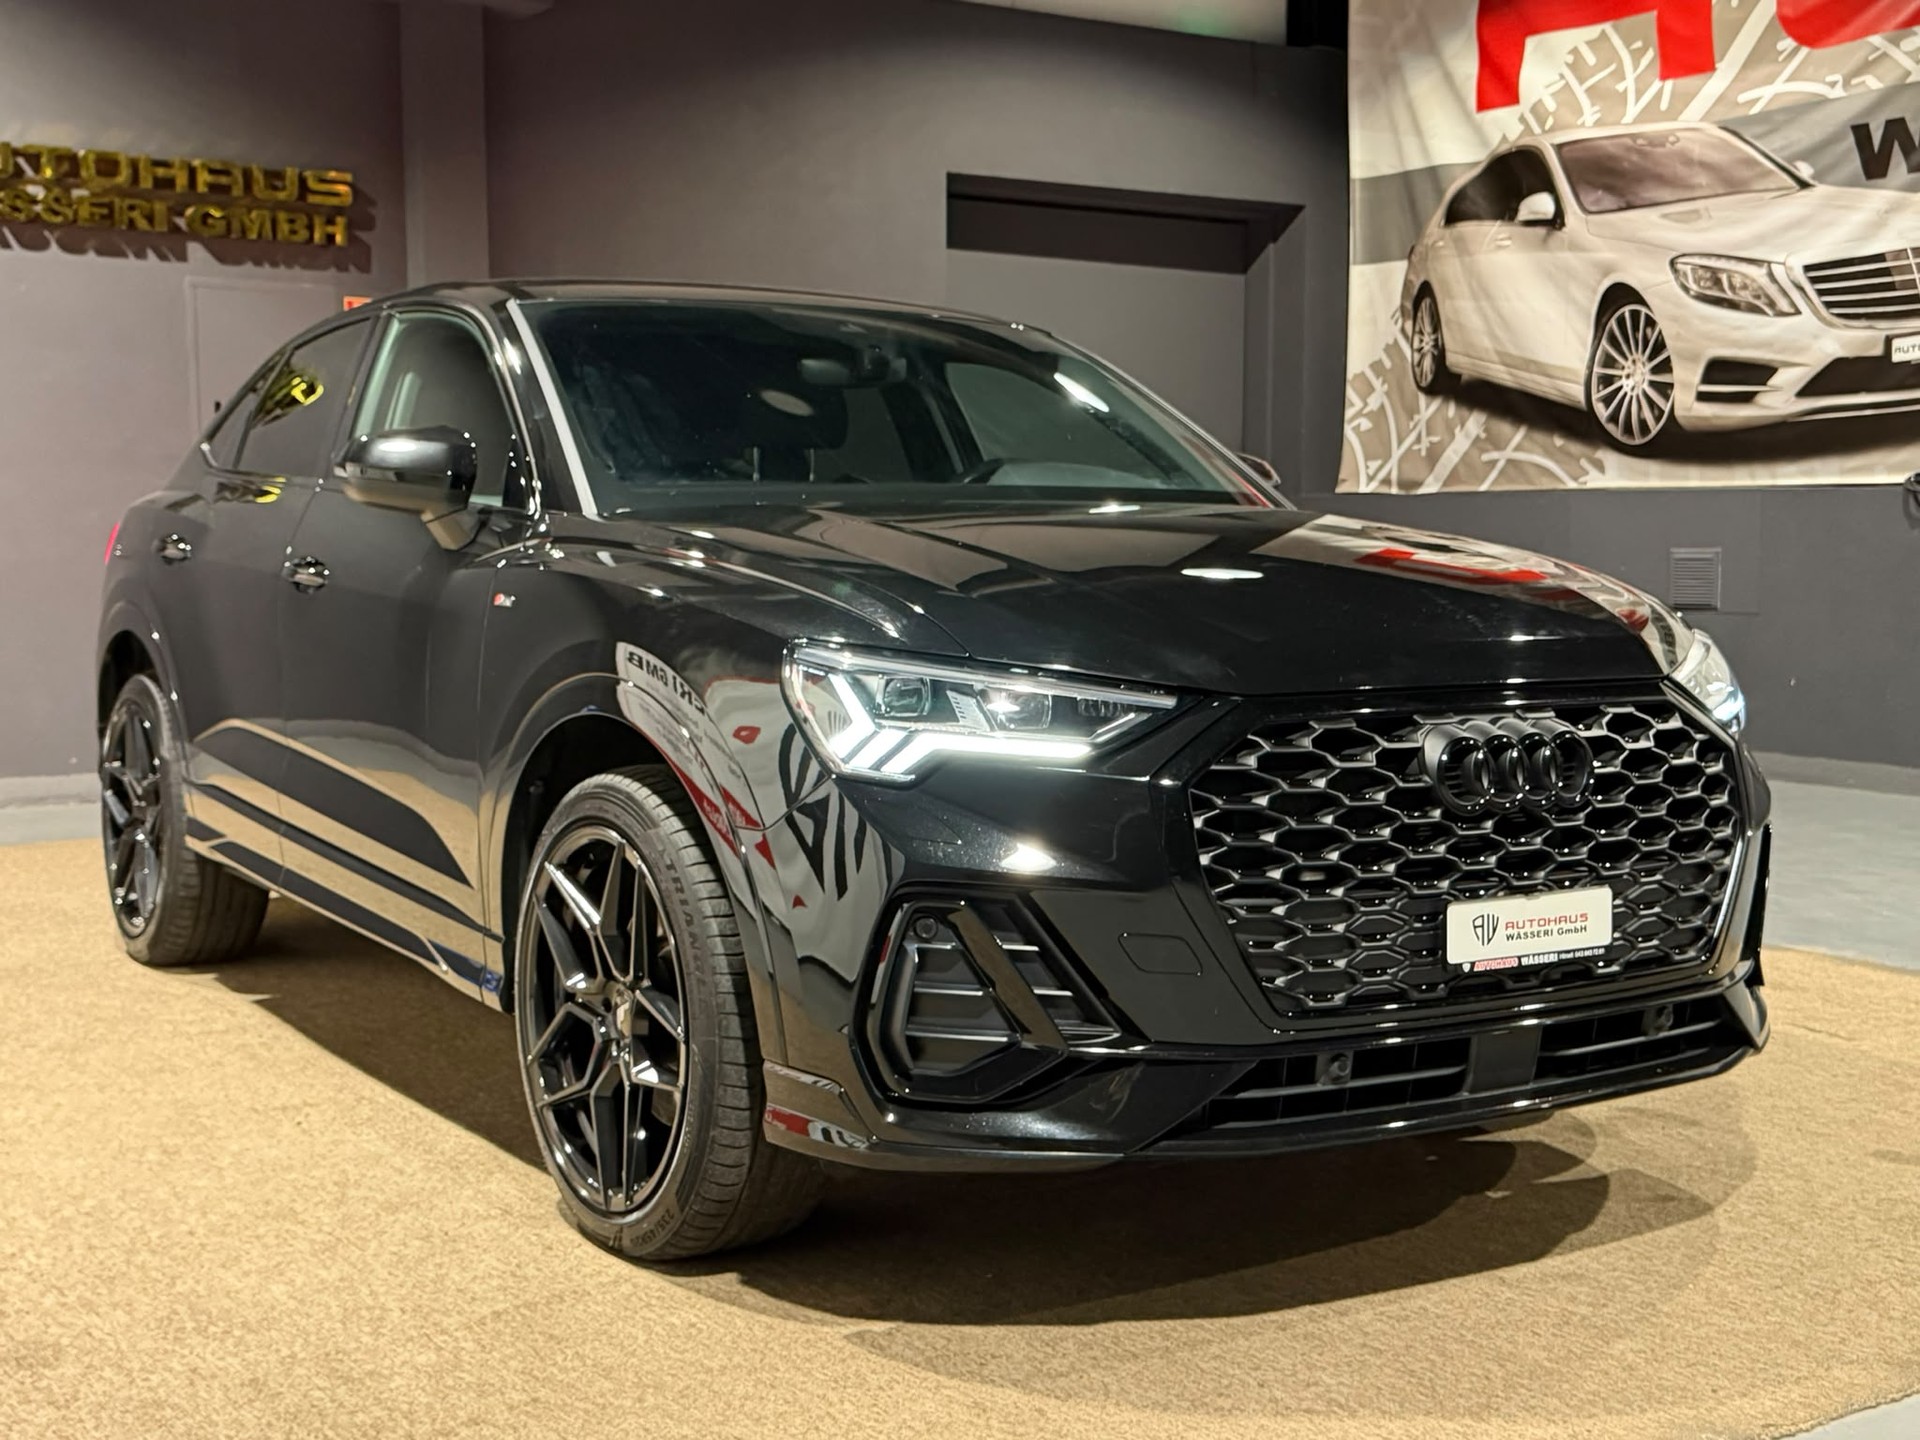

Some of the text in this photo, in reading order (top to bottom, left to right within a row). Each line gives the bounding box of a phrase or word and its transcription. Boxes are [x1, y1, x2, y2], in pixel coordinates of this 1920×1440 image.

[186, 204, 348, 247] GMBH
[1894, 343, 1920, 354] AUT
[1505, 913, 1588, 931] AUTOHAUS
[1557, 925, 1587, 936] GmbH
